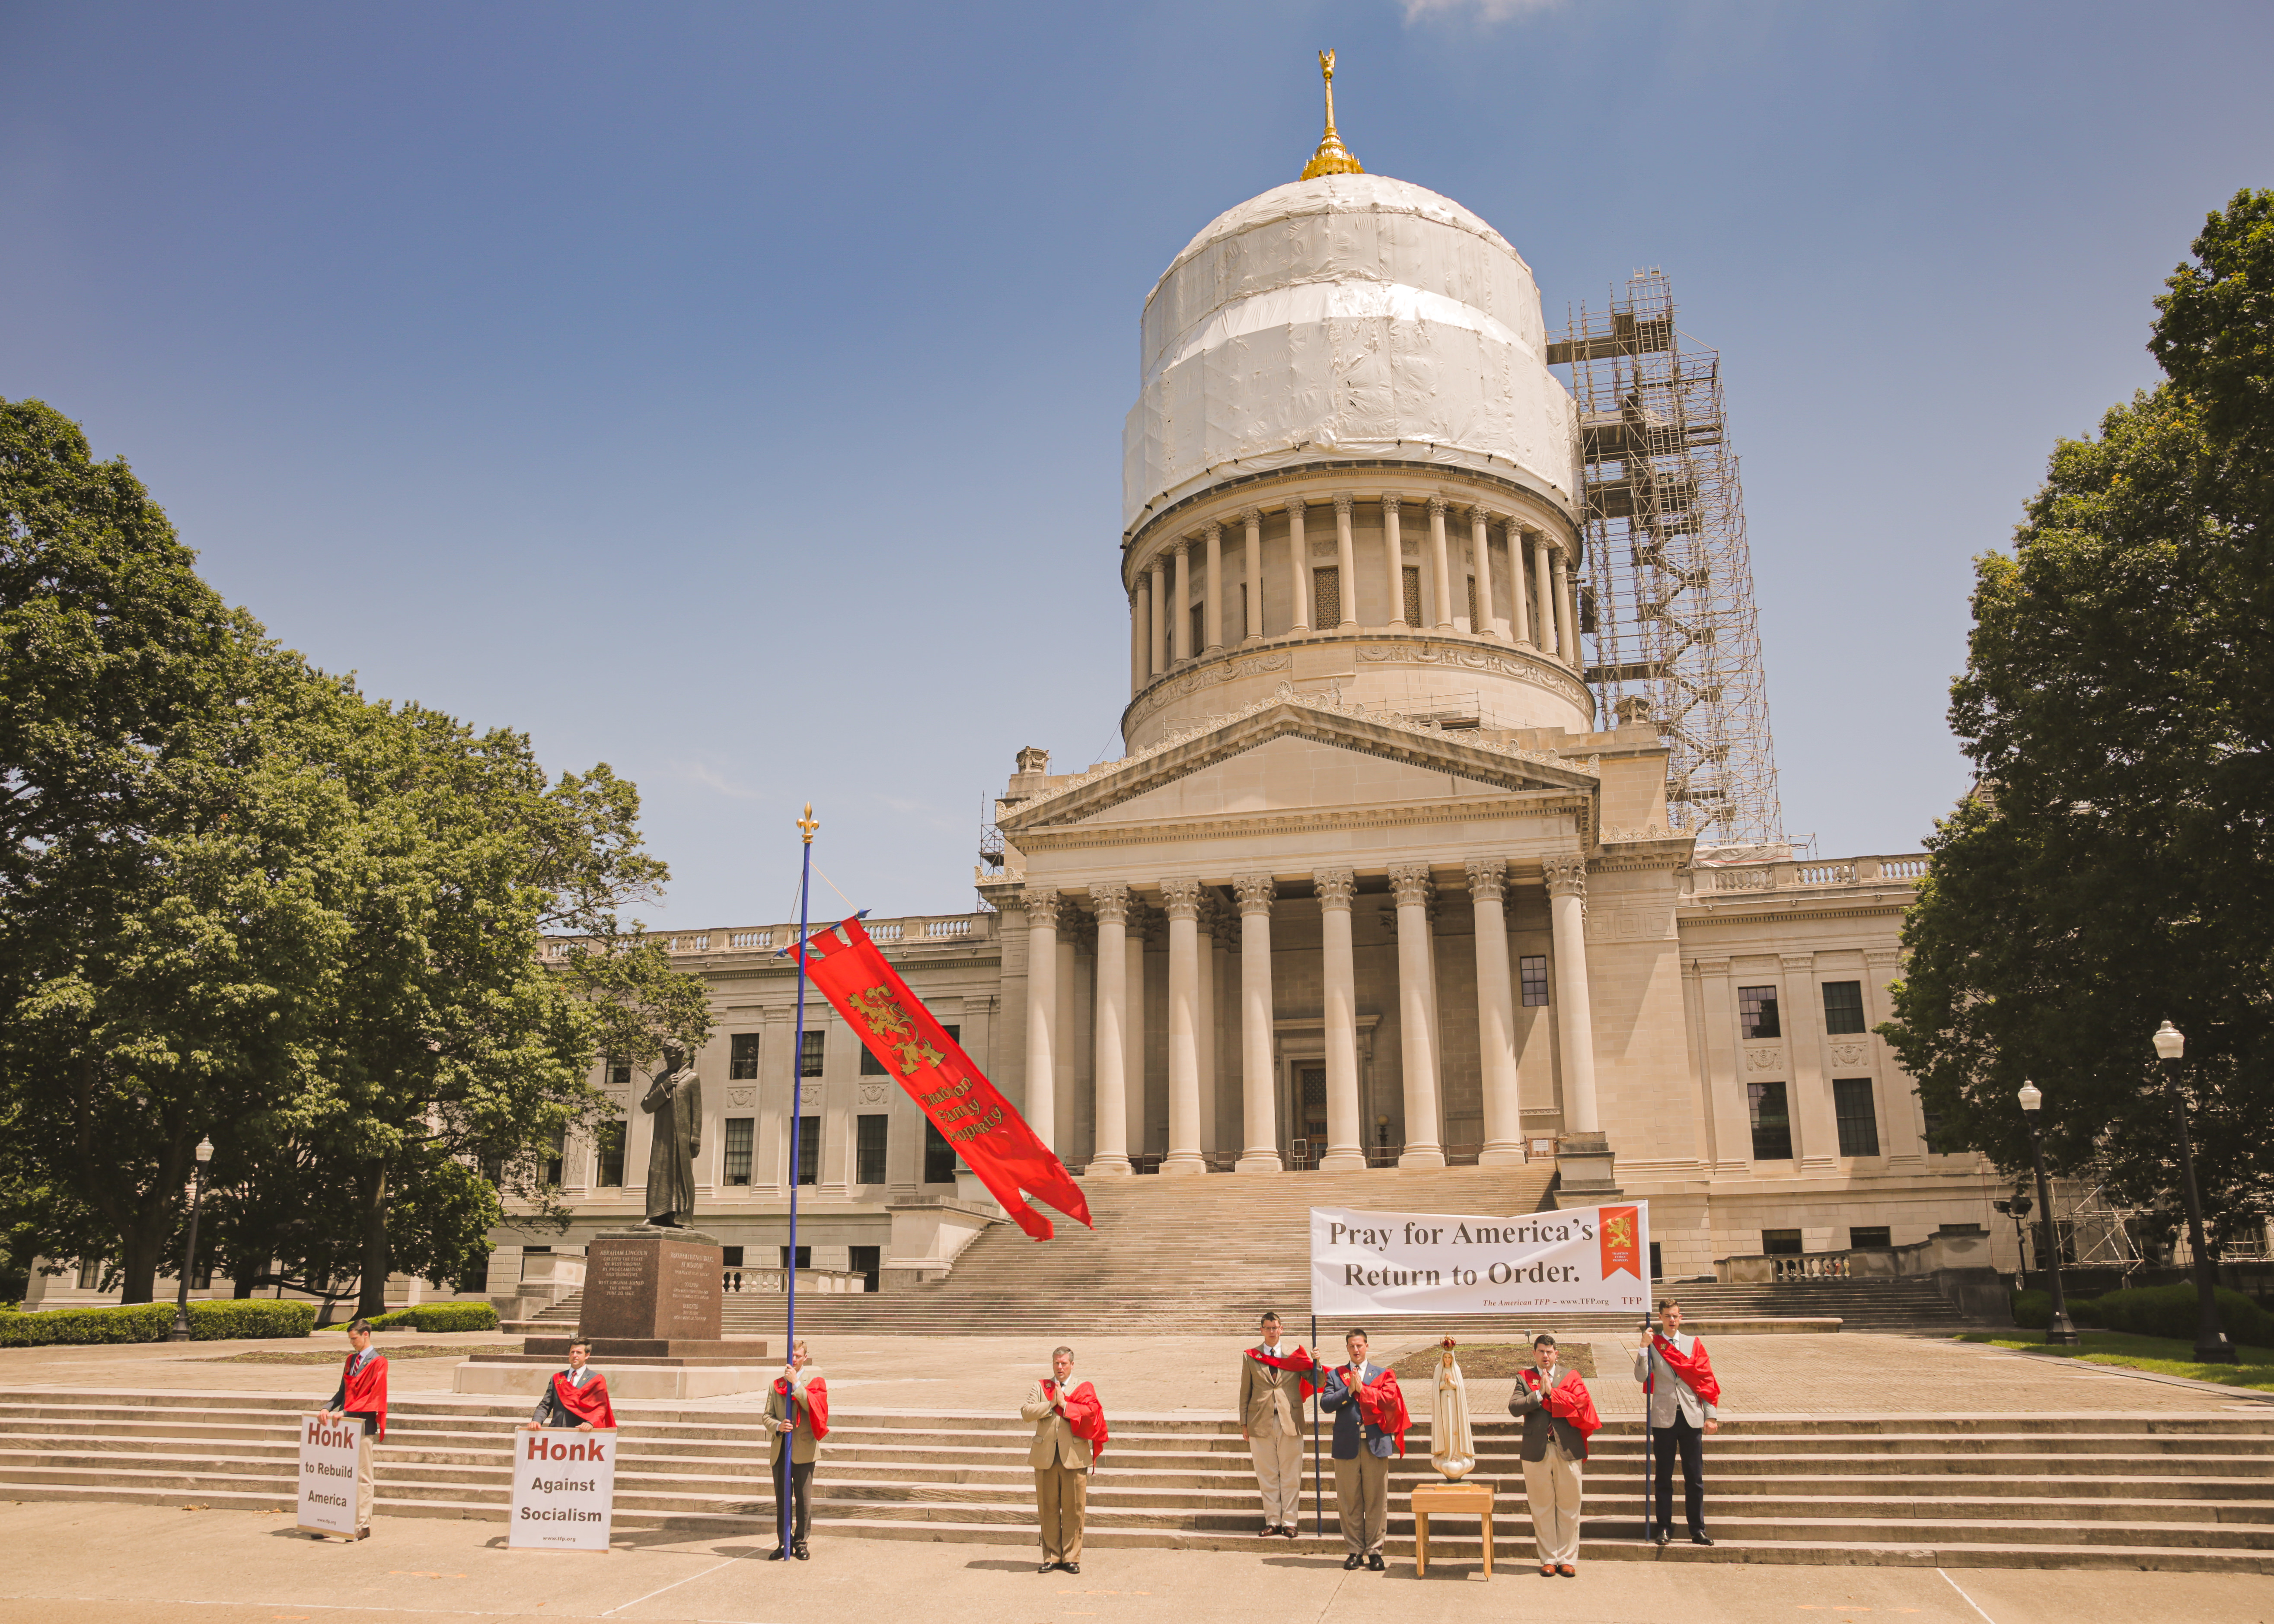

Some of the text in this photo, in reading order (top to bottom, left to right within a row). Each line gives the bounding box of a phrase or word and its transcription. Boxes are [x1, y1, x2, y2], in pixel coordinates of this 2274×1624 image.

[1328, 1219, 1593, 1251] Pray for America's
[1343, 1261, 1579, 1286] Return to Order.
[308, 1422, 354, 1449] Honk
[527, 1437, 605, 1461] Honk
[305, 1461, 353, 1478] to Rebuild
[531, 1478, 595, 1493] Against
[308, 1490, 347, 1507] America
[520, 1507, 601, 1522] Socialism
